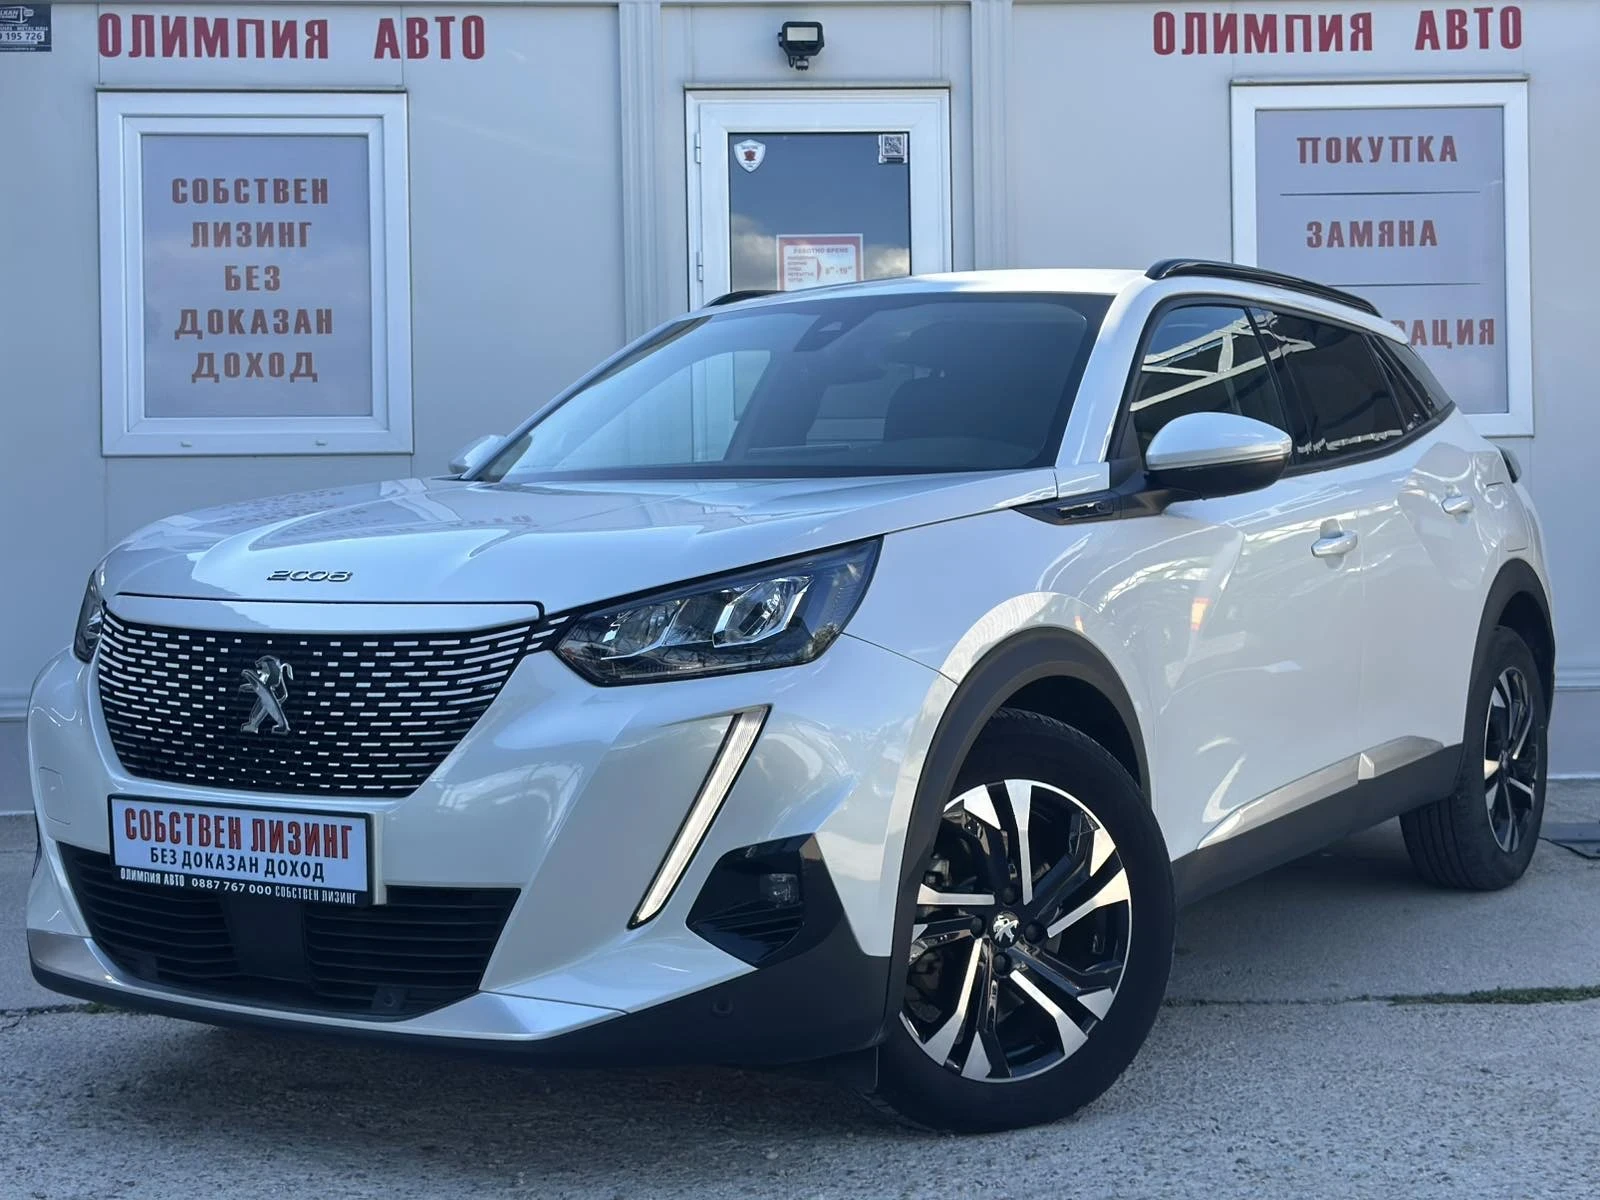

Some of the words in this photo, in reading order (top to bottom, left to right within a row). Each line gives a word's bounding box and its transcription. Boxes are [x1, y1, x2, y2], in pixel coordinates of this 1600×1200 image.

[25, 32, 42, 41] 726
[99, 13, 329, 59] ОЛИМПИЯ
[374, 15, 486, 60] АВТО
[1153, 11, 1373, 55] ОЛИМПИЯ
[1414, 6, 1523, 51] АВТО
[1296, 135, 1458, 164] ПОКУПКА
[172, 178, 328, 204] СОБСТВЕН
[190, 221, 312, 248] ЛИЗИНГ
[1306, 219, 1438, 249] ЗАМЯНА
[224, 265, 281, 291] БЕЗ
[174, 308, 333, 340] ДОКАЗАН
[191, 352, 318, 384] ДОХОД
[266, 569, 353, 583] 2008
[124, 807, 242, 850] СОБСТВЕН
[251, 817, 353, 860] ЛИЗИНГ
[150, 847, 177, 865] БЕЗ
[181, 850, 259, 873] ДОКАЗАН
[264, 858, 325, 883] ДОХОД
[120, 868, 161, 885] ОЛИМПИЯ
[163, 872, 185, 887] АВТО
[191, 877, 220, 890] 0887
[224, 881, 245, 893] 767
[249, 884, 272, 896] 000
[275, 885, 319, 901] СОБСТВЕН
[322, 890, 356, 905] ЛИЗИНГ
